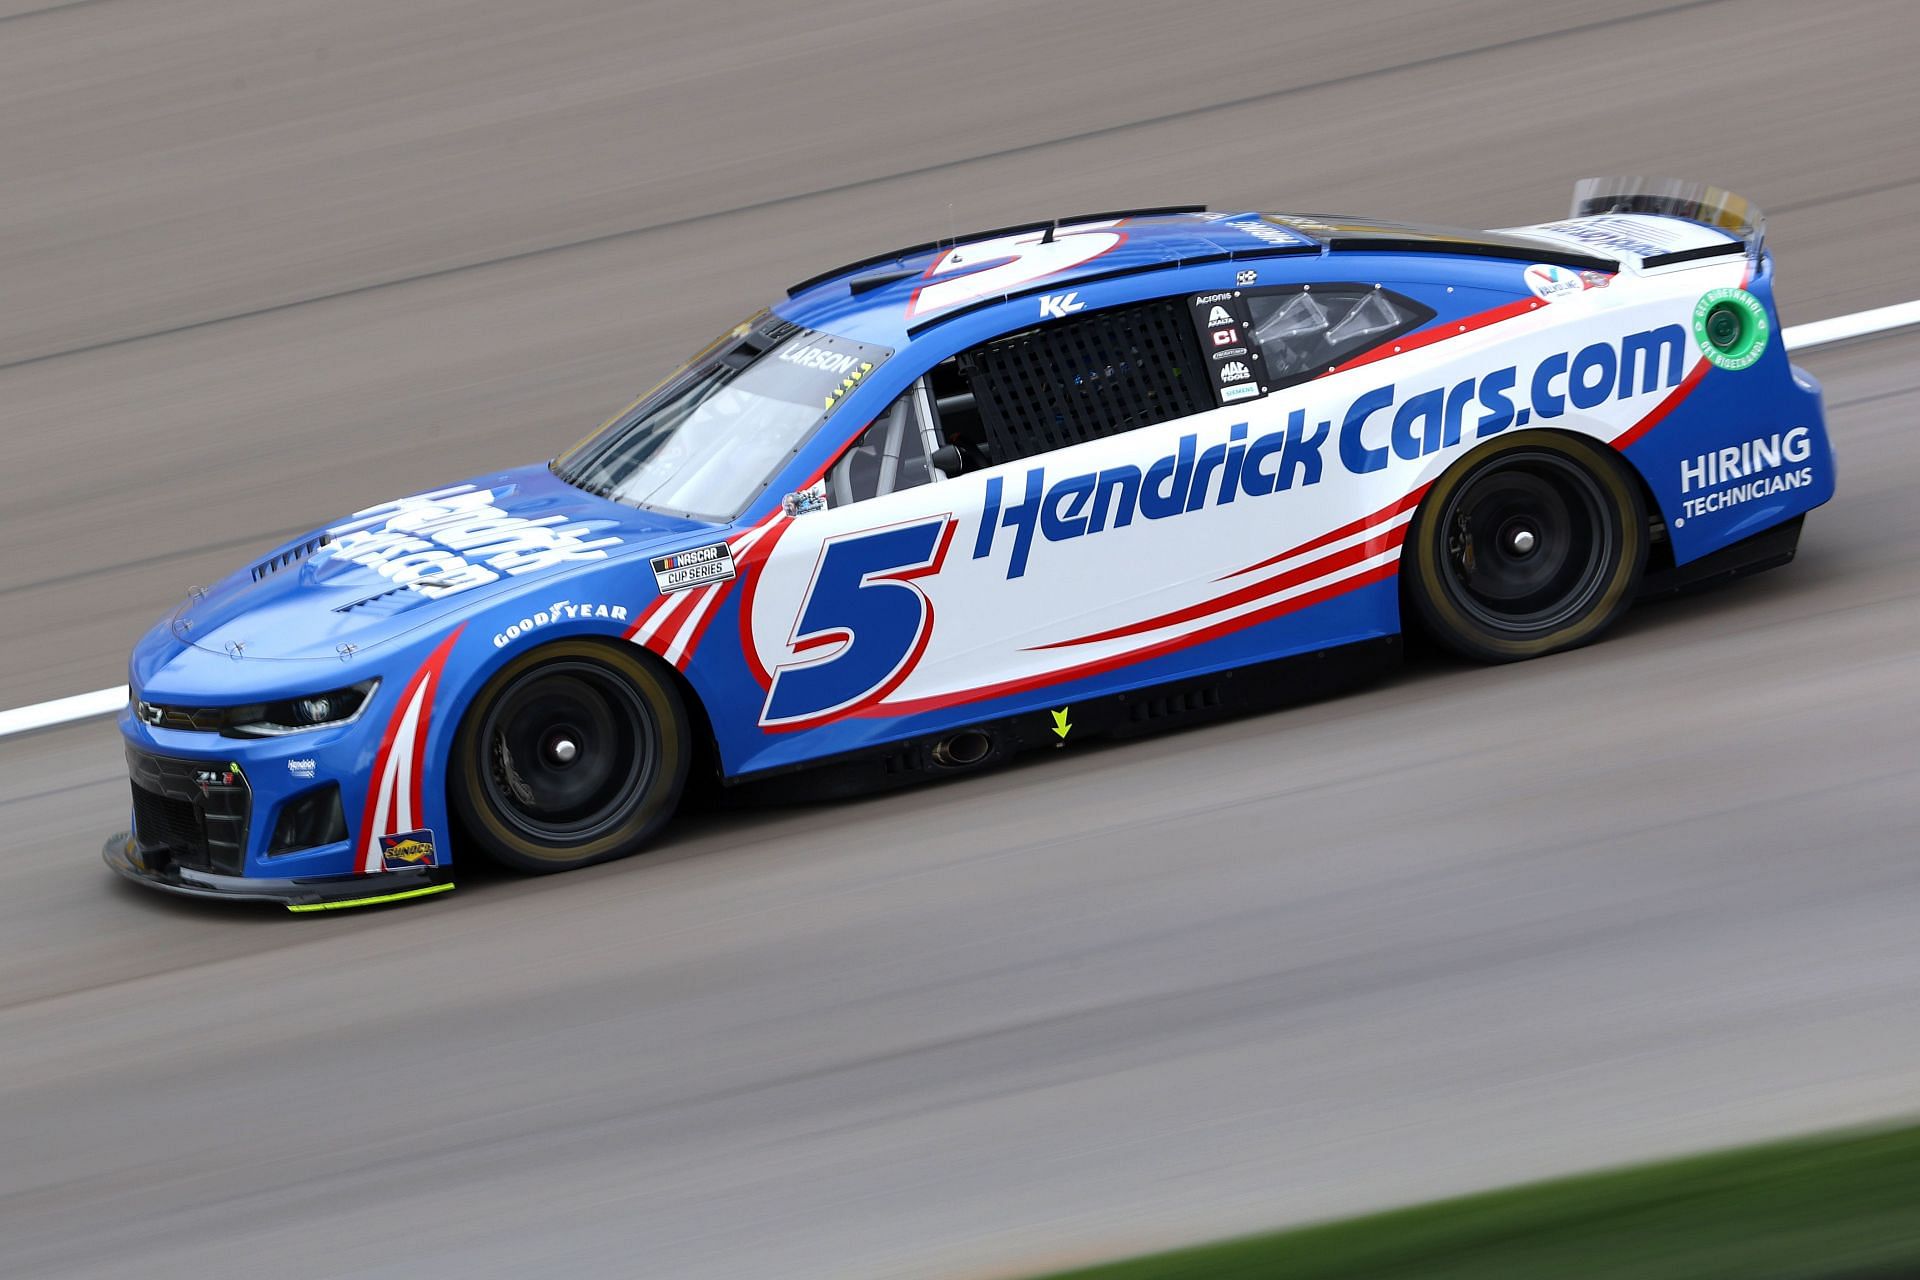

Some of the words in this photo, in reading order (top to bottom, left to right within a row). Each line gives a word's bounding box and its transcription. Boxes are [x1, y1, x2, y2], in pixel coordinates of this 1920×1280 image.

[1196, 292, 1232, 307] Acronis
[779, 342, 859, 374] LARSON
[1221, 361, 1250, 379] MAC
[1223, 372, 1251, 383] TOOLS
[1680, 427, 1811, 493] HIRING
[1683, 467, 1813, 518] TECHNICIANS
[676, 547, 718, 566] NASCAR
[668, 571, 689, 584] CUP
[689, 562, 723, 580] SERIES
[759, 512, 955, 734] 5
[384, 841, 433, 859] SUNOCO
